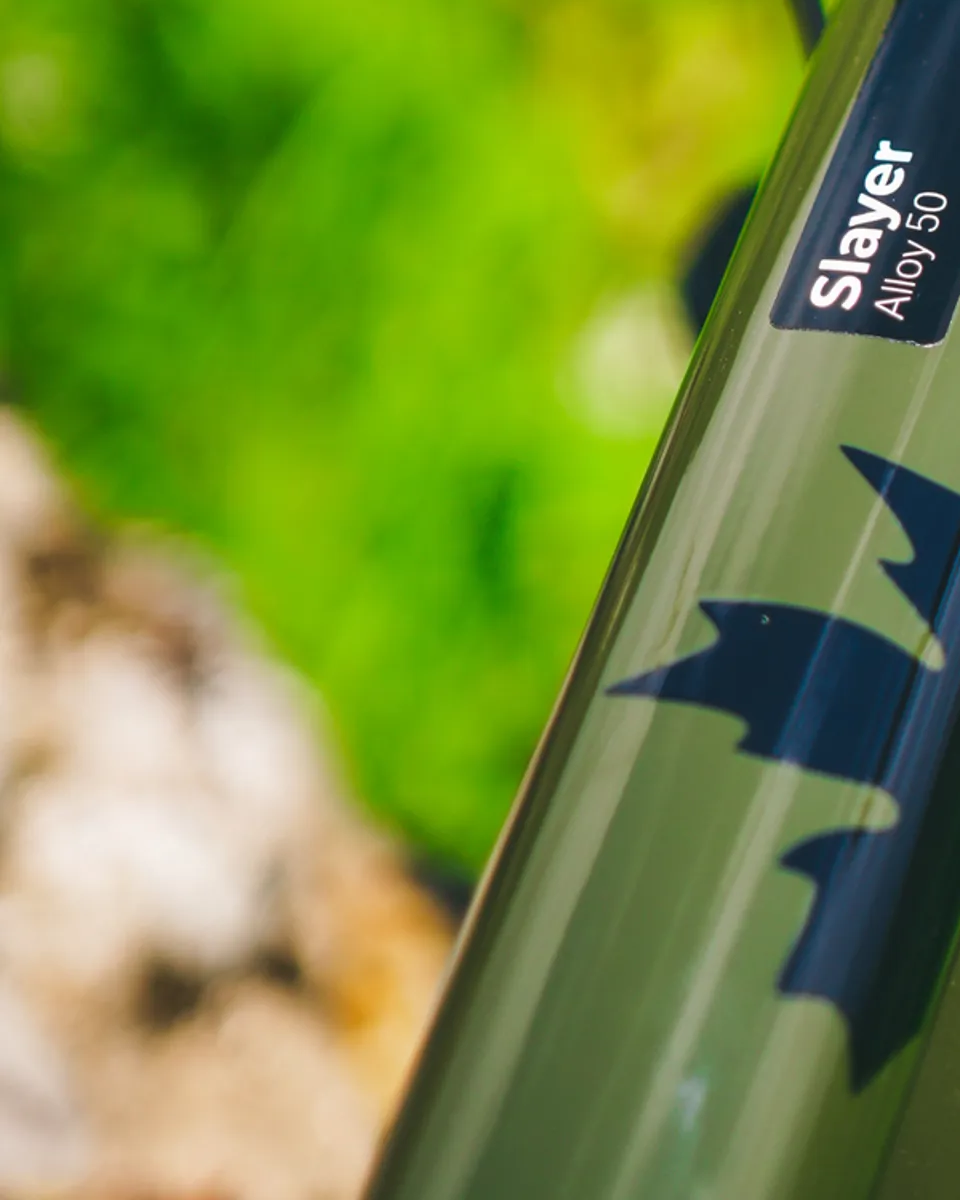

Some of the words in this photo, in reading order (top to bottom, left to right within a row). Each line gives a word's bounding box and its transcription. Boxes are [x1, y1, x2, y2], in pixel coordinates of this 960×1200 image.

[808, 139, 914, 311] Slayer
[904, 191, 949, 233] 50
[873, 238, 937, 321] Alloy
